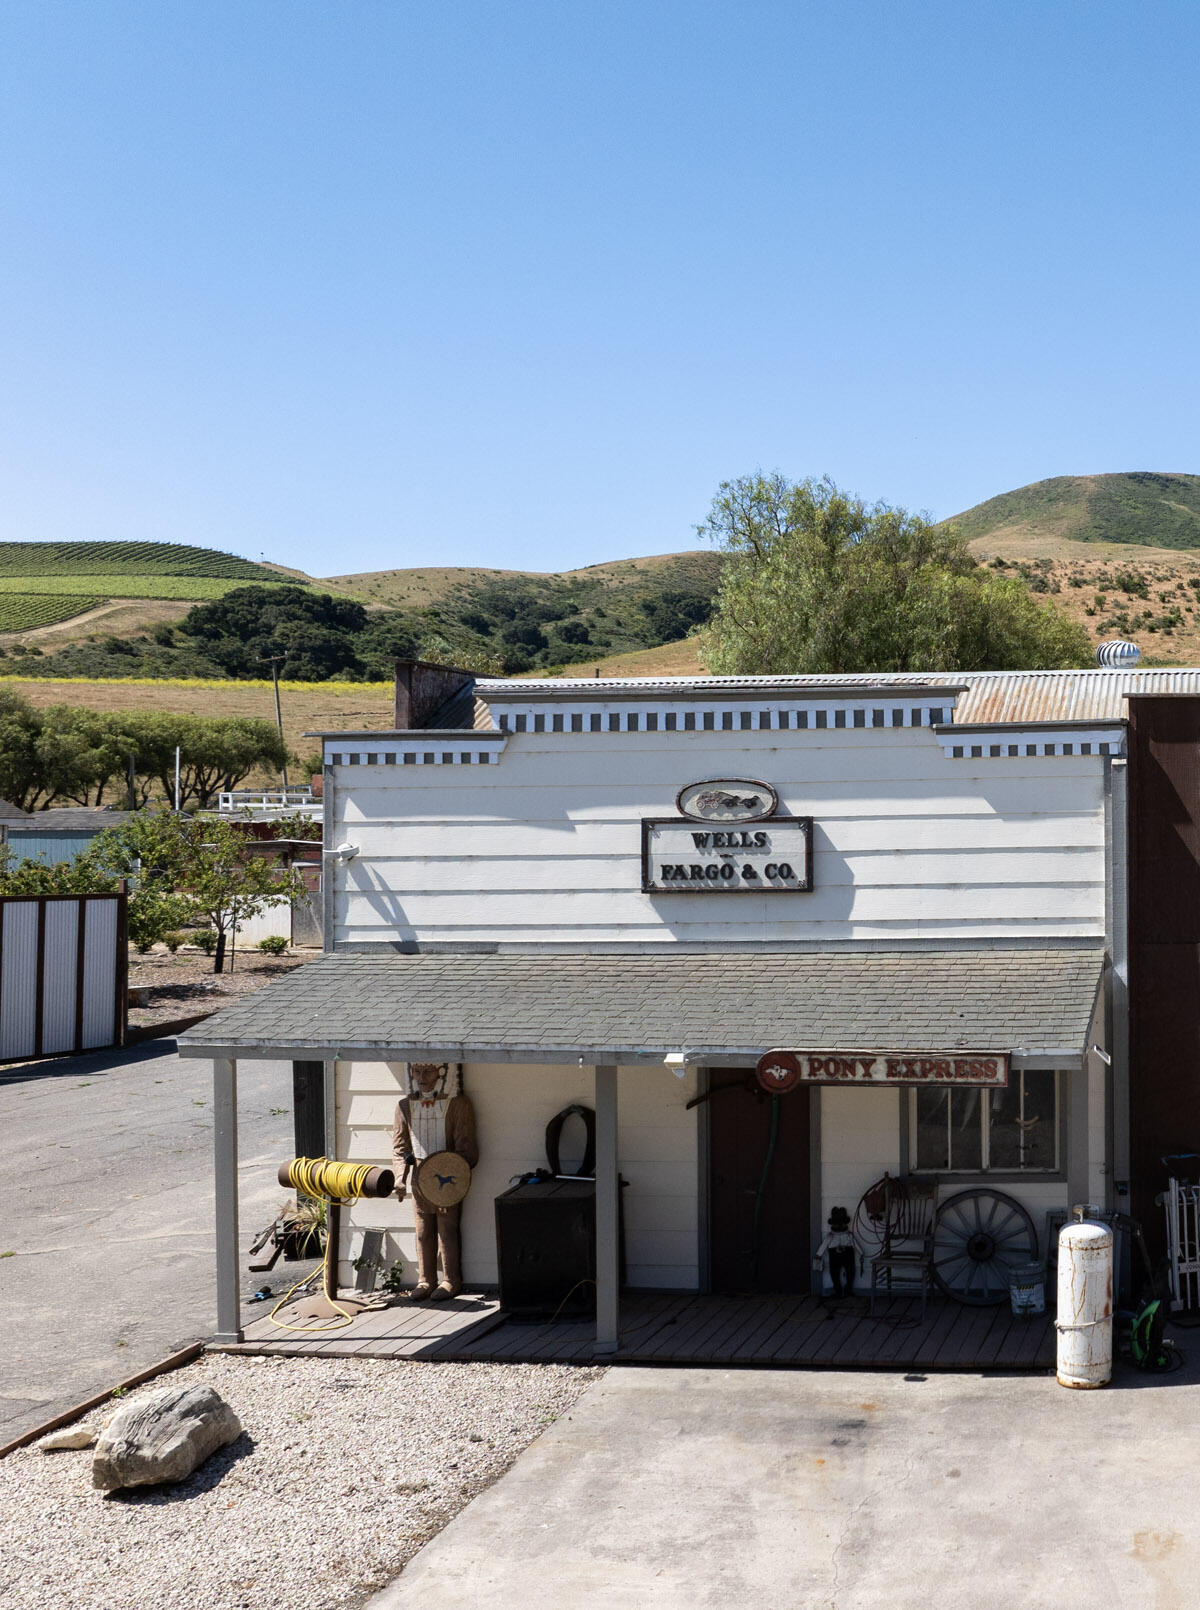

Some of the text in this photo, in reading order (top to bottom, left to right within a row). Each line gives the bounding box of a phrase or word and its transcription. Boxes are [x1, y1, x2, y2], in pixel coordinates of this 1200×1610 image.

[691, 832, 767, 849] WELLS
[661, 863, 795, 881] FARGO & CO.
[808, 1057, 998, 1080] PONY EXPRESS
